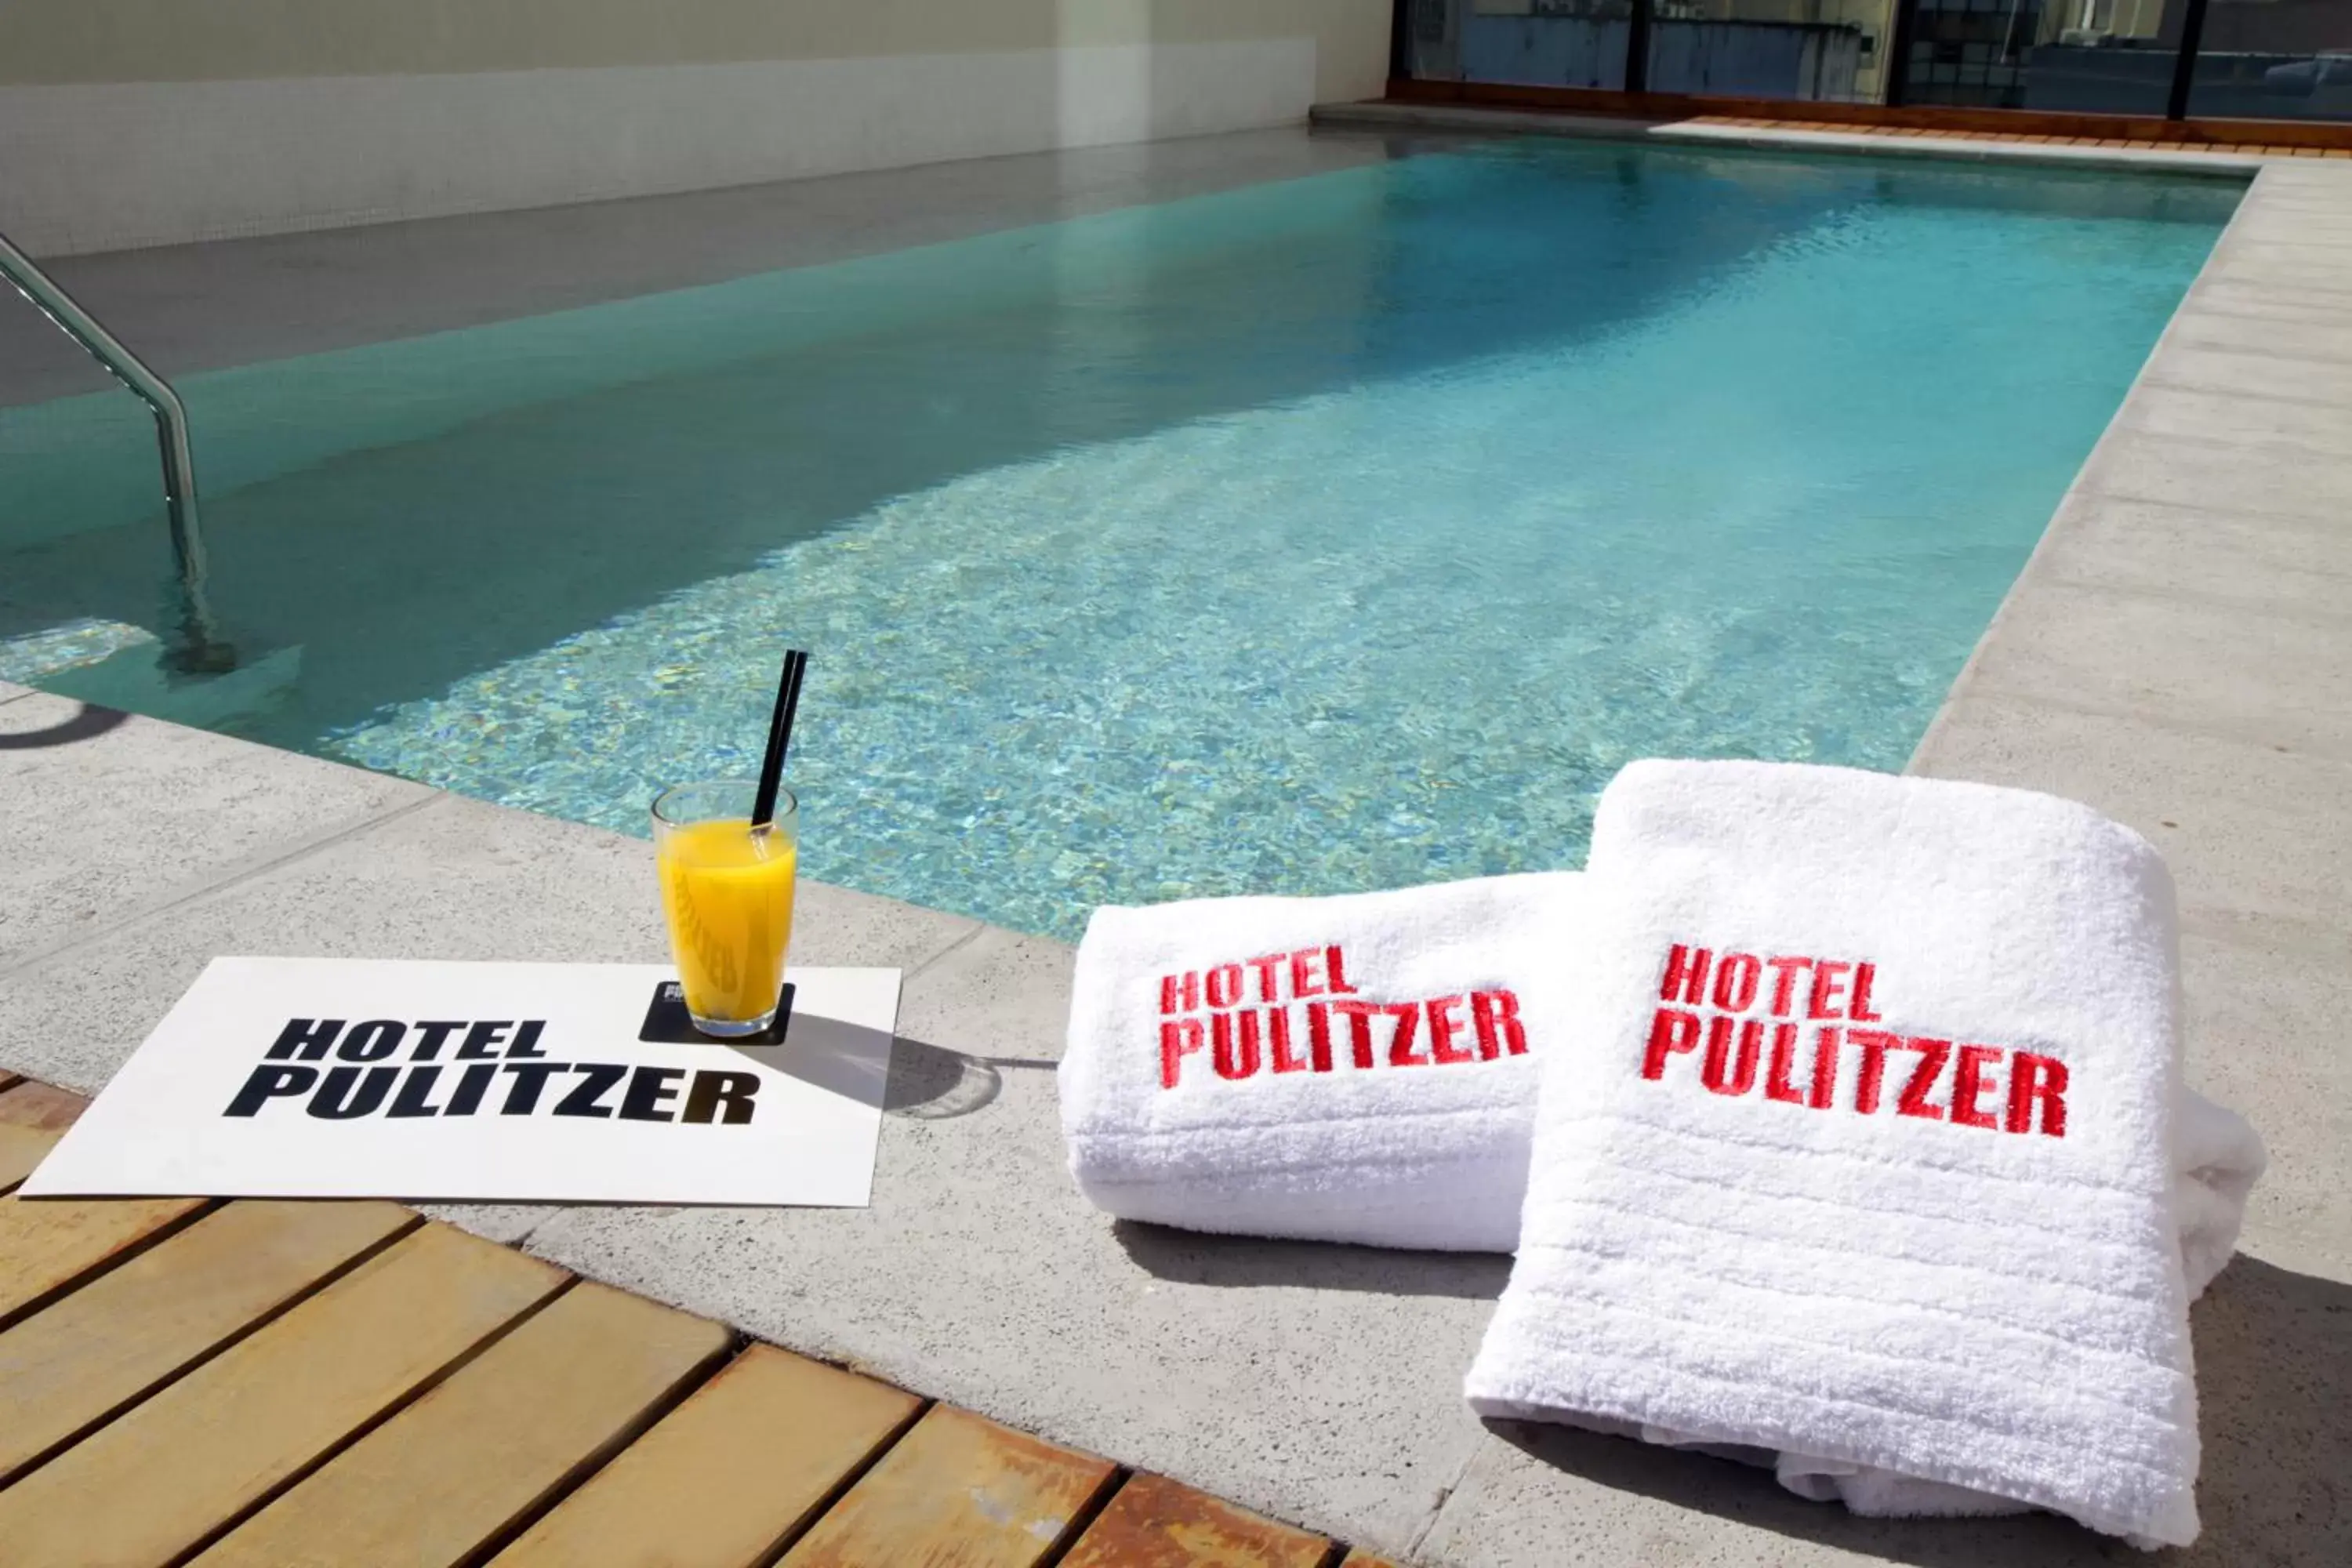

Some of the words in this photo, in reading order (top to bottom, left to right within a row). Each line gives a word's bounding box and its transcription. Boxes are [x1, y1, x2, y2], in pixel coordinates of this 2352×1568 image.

[1160, 945, 1358, 1014] HOTEL
[1659, 944, 1882, 1022] HOTEL
[264, 1018, 547, 1062] HOTEL
[1160, 989, 1528, 1089] PULITZER
[1642, 1008, 2069, 1138] PULITZER
[223, 1062, 760, 1124] PULITZER
